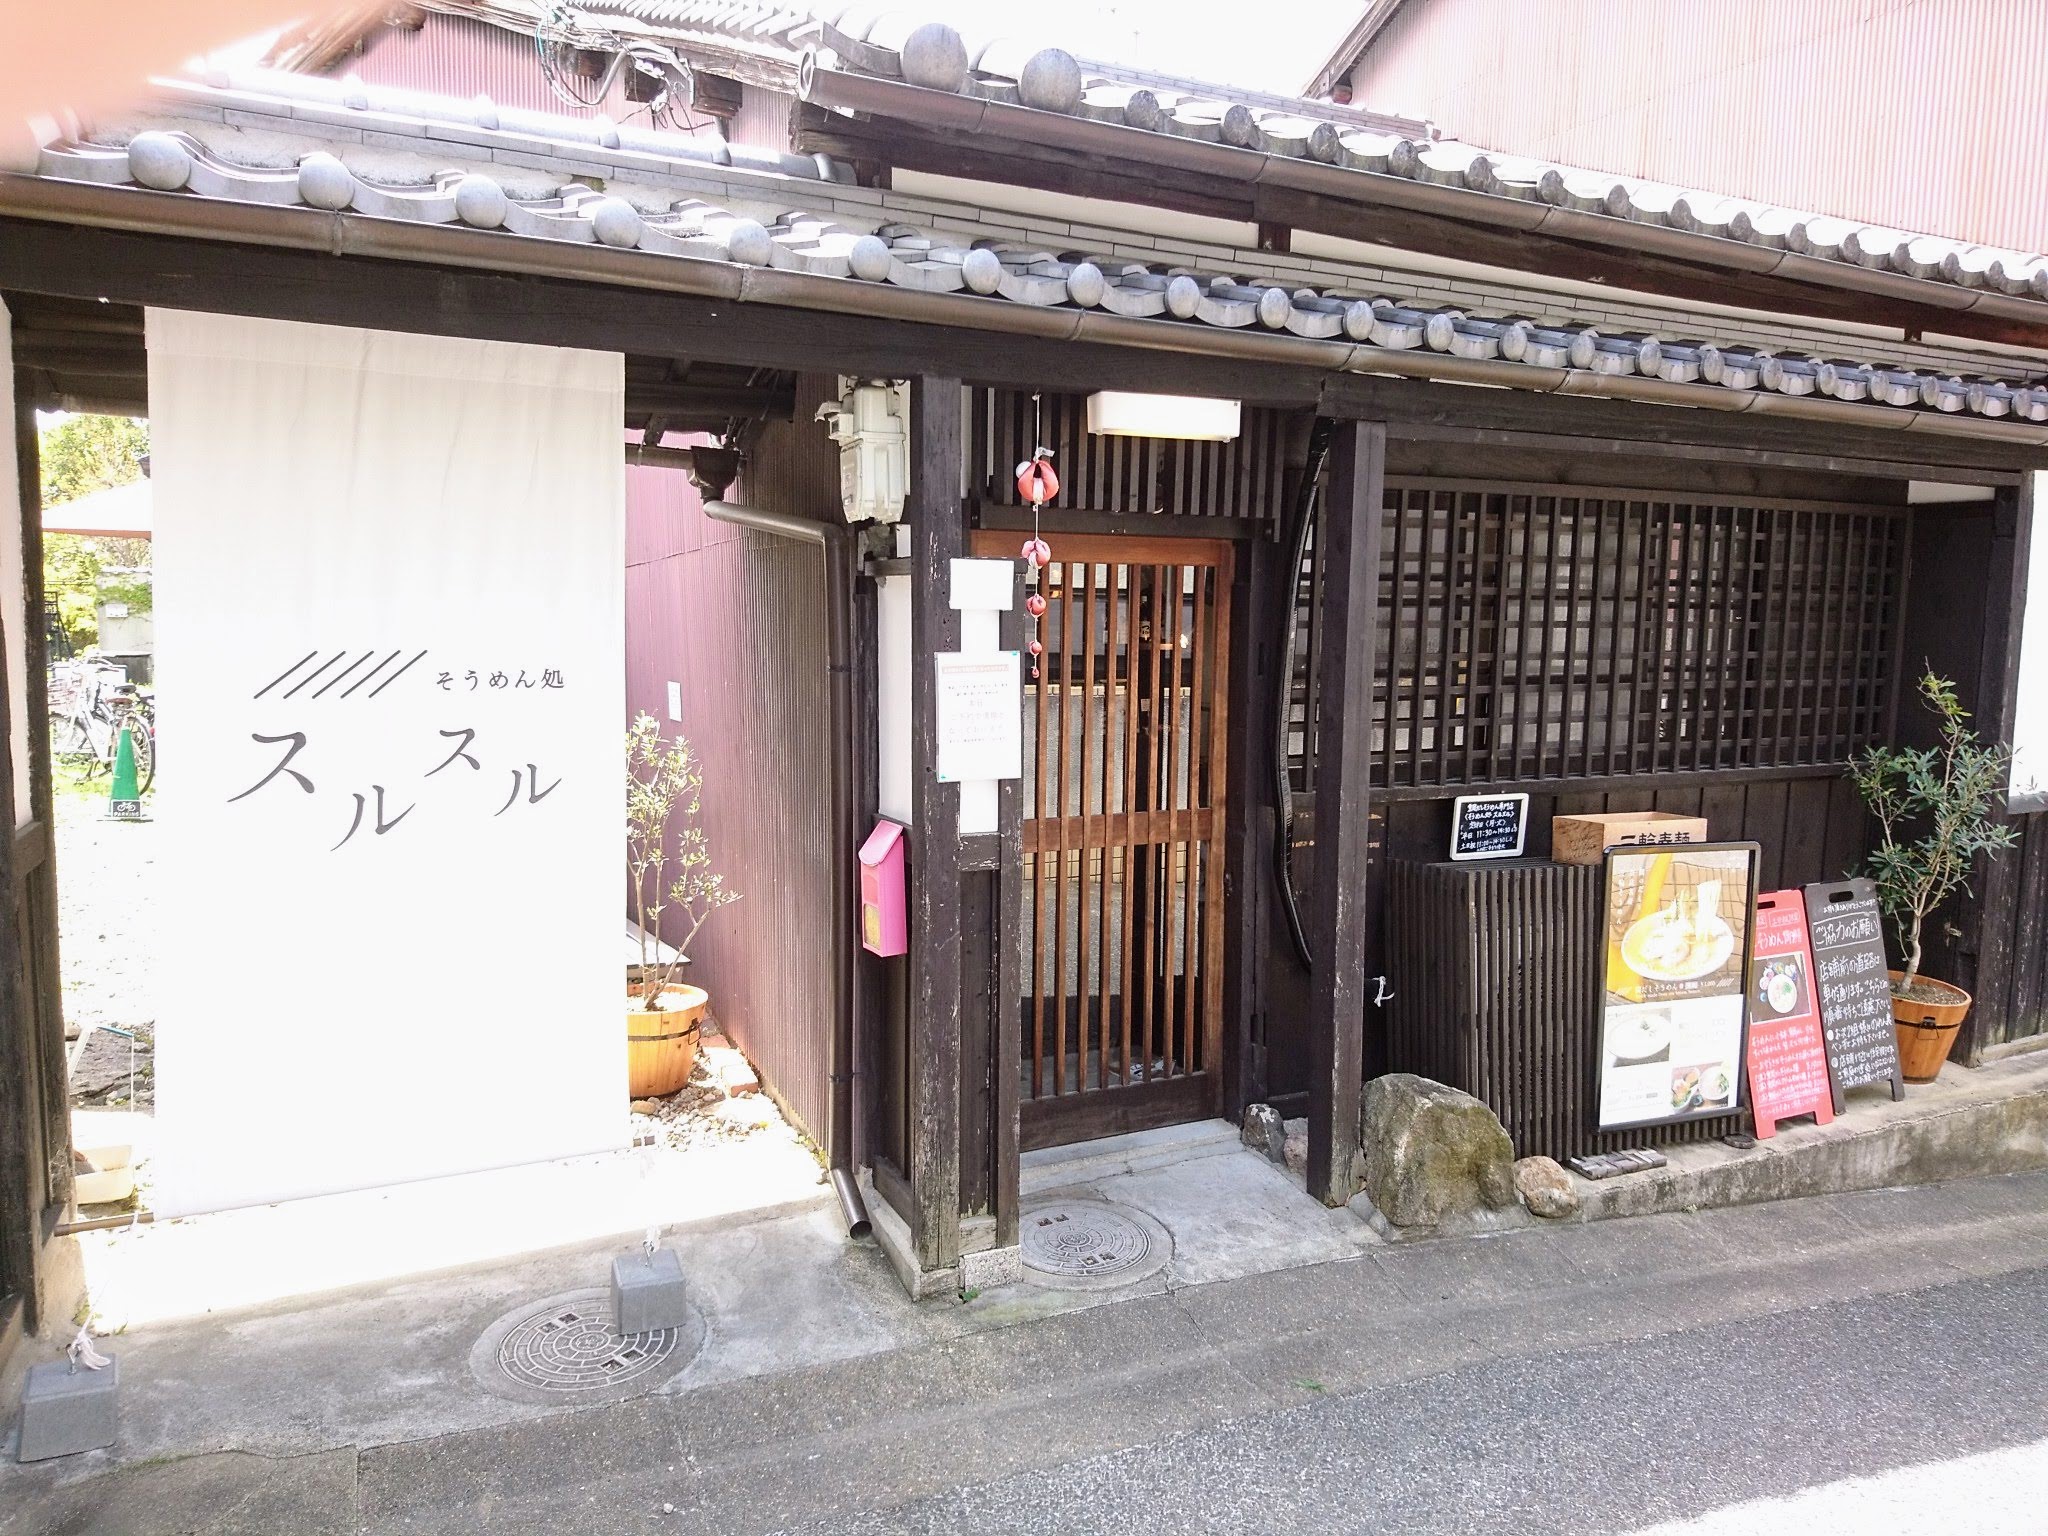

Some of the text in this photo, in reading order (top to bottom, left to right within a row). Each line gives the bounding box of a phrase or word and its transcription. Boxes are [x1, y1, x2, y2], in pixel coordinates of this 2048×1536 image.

[436, 668, 565, 692] そうめん処
[227, 728, 562, 852] スルスル
[1816, 918, 1878, 945] ご協力のお願い
[1820, 952, 1880, 982] 店舗前の道路は
